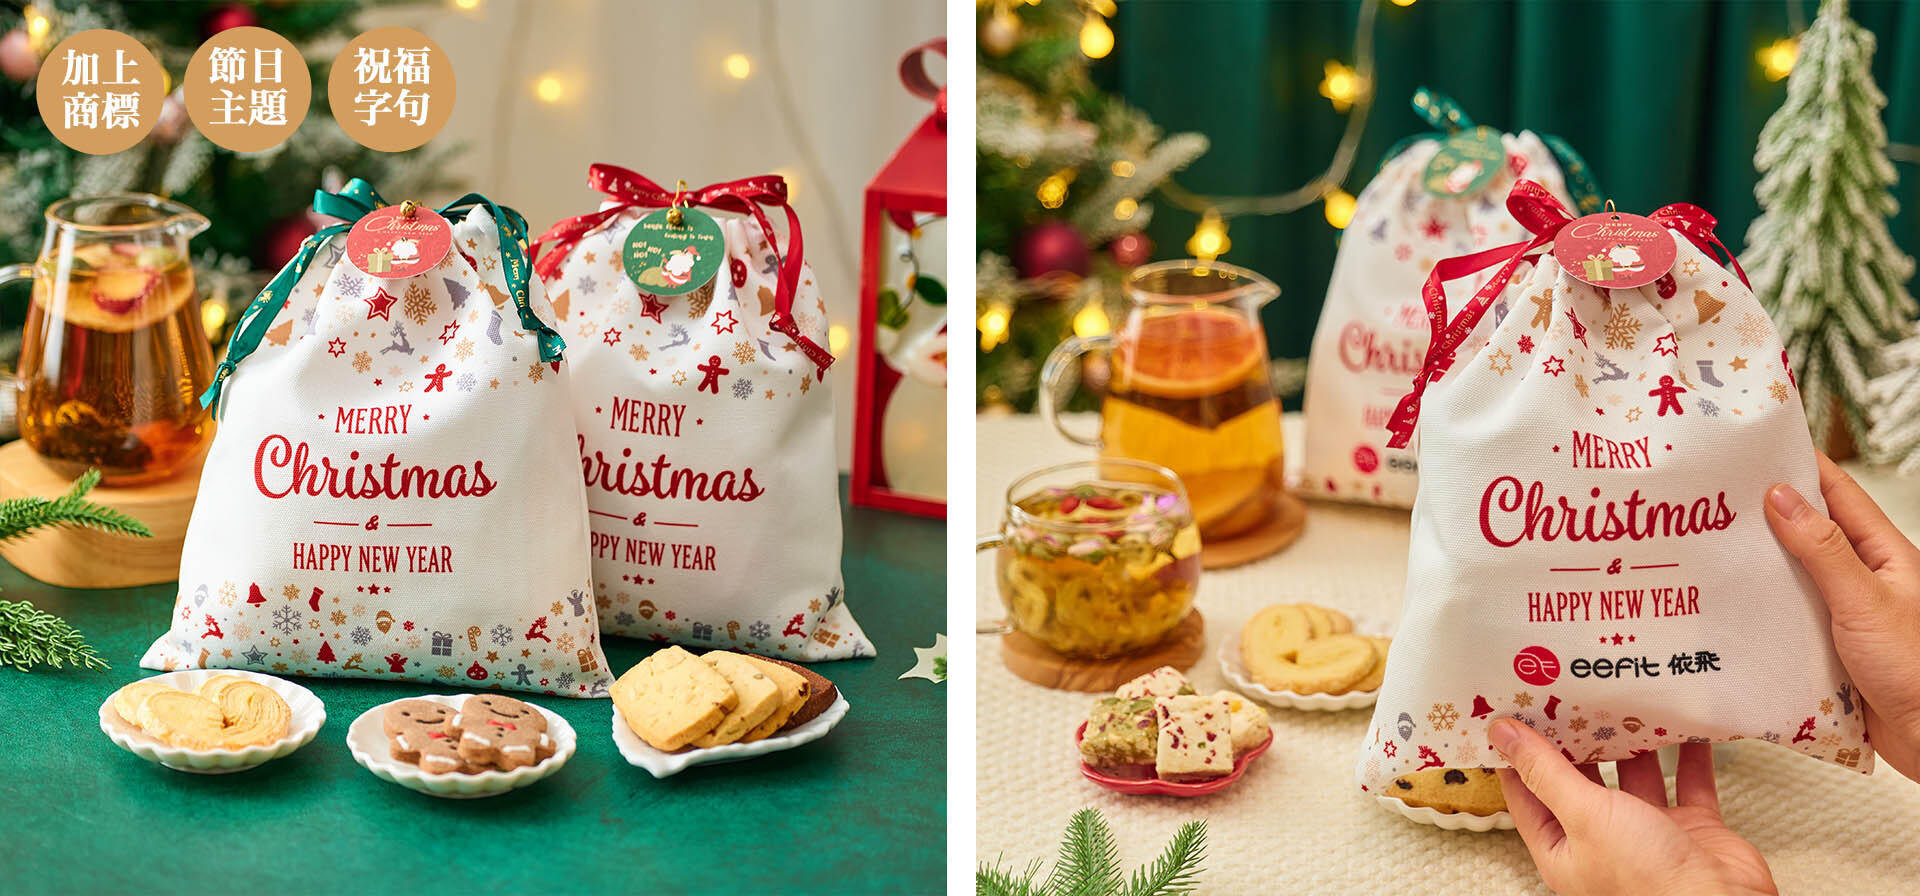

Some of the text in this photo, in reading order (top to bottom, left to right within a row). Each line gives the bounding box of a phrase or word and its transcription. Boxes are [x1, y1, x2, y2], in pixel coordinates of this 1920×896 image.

[364, 215, 441, 232] Christmas
[1571, 223, 1660, 238] Christmas
[1429, 287, 1443, 334] Christmas
[1441, 309, 1475, 349] Christmas
[335, 404, 412, 434] MERRY
[611, 396, 687, 438] MERRY
[254, 434, 498, 500] Christmas
[577, 434, 765, 502] hristmas
[1572, 430, 1652, 469] MERRY
[365, 514, 380, 531] &
[1479, 475, 1737, 548] Christmas
[293, 542, 453, 573] HAPPY NEW YEAR
[591, 531, 716, 571] PPY NEW YEAR
[1606, 557, 1622, 575] &
[1528, 586, 1700, 622] HAPPY NEW YEAR
[1667, 650, 1721, 676] 依飛
